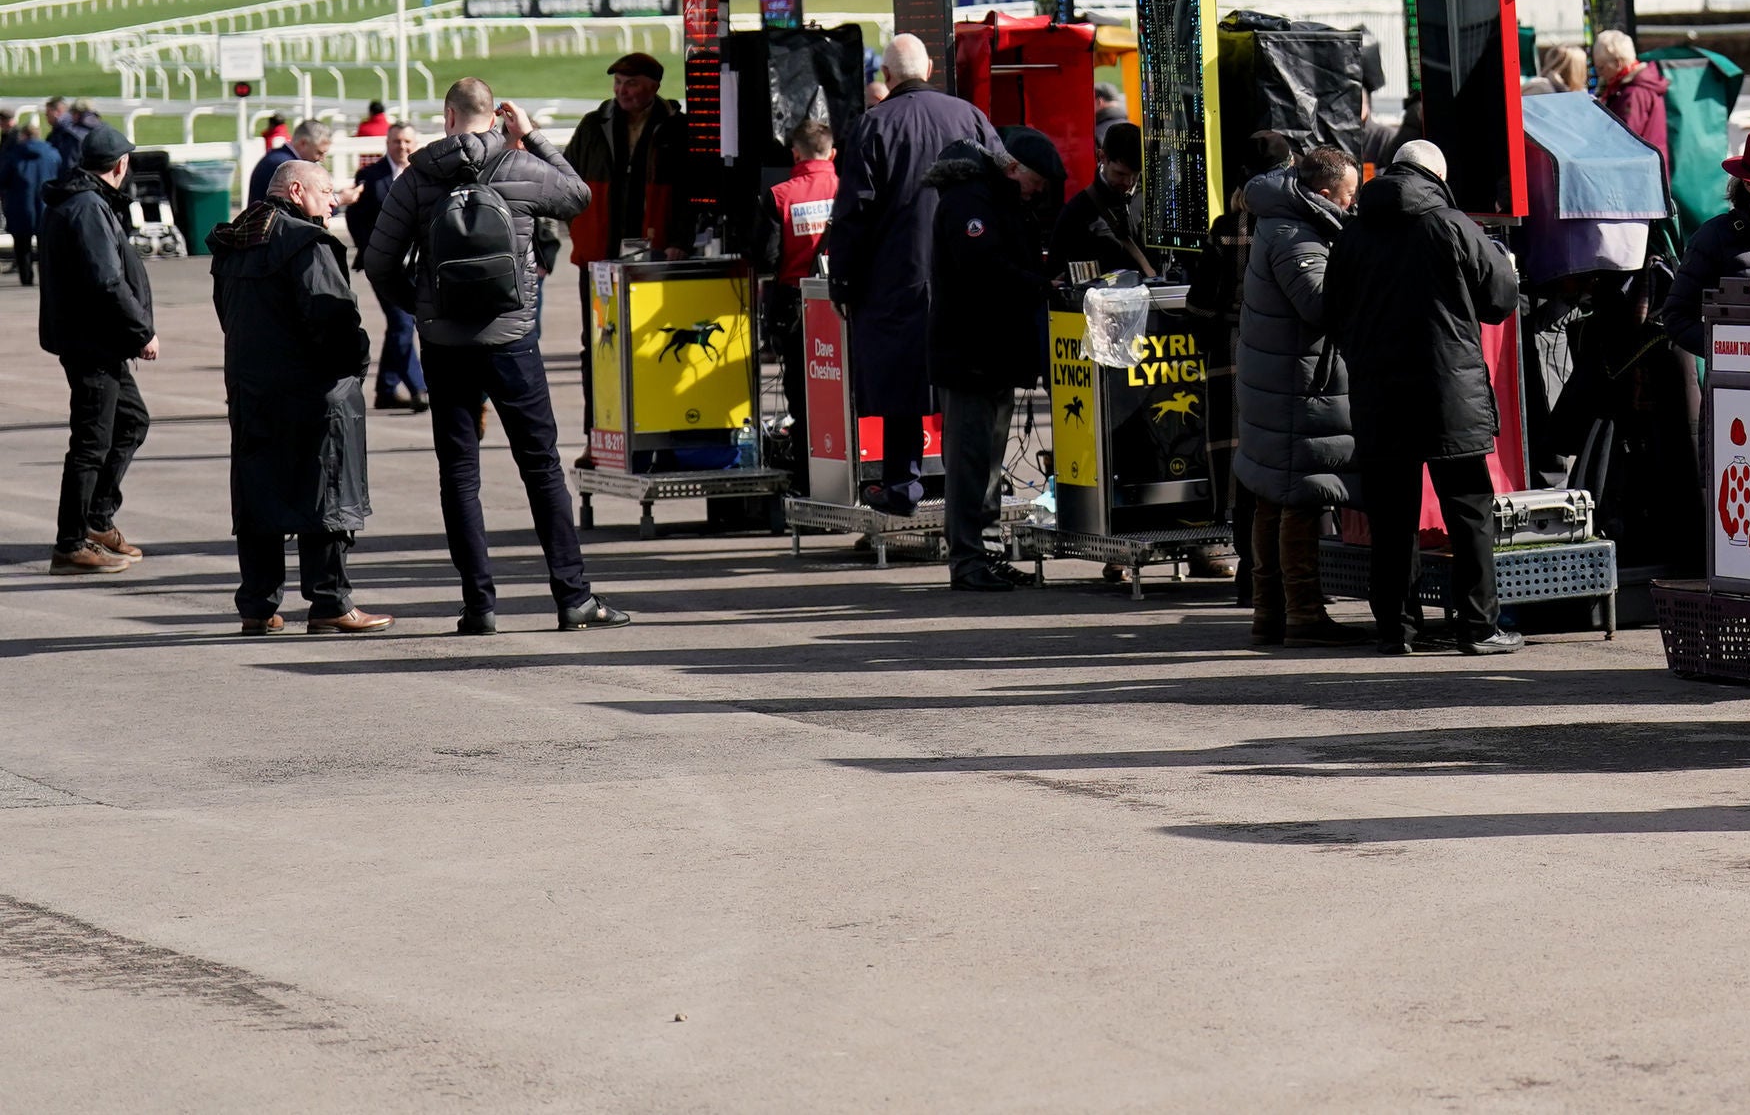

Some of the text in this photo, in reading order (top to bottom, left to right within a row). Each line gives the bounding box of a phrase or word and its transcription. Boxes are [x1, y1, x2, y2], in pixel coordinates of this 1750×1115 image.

[793, 205, 824, 217] RACEC
[815, 338, 834, 357] Dave
[1132, 333, 1197, 359] CYRI
[1714, 340, 1739, 355] GRAHAM
[809, 361, 841, 381] Cheshire
[1053, 363, 1091, 388] LYNCH
